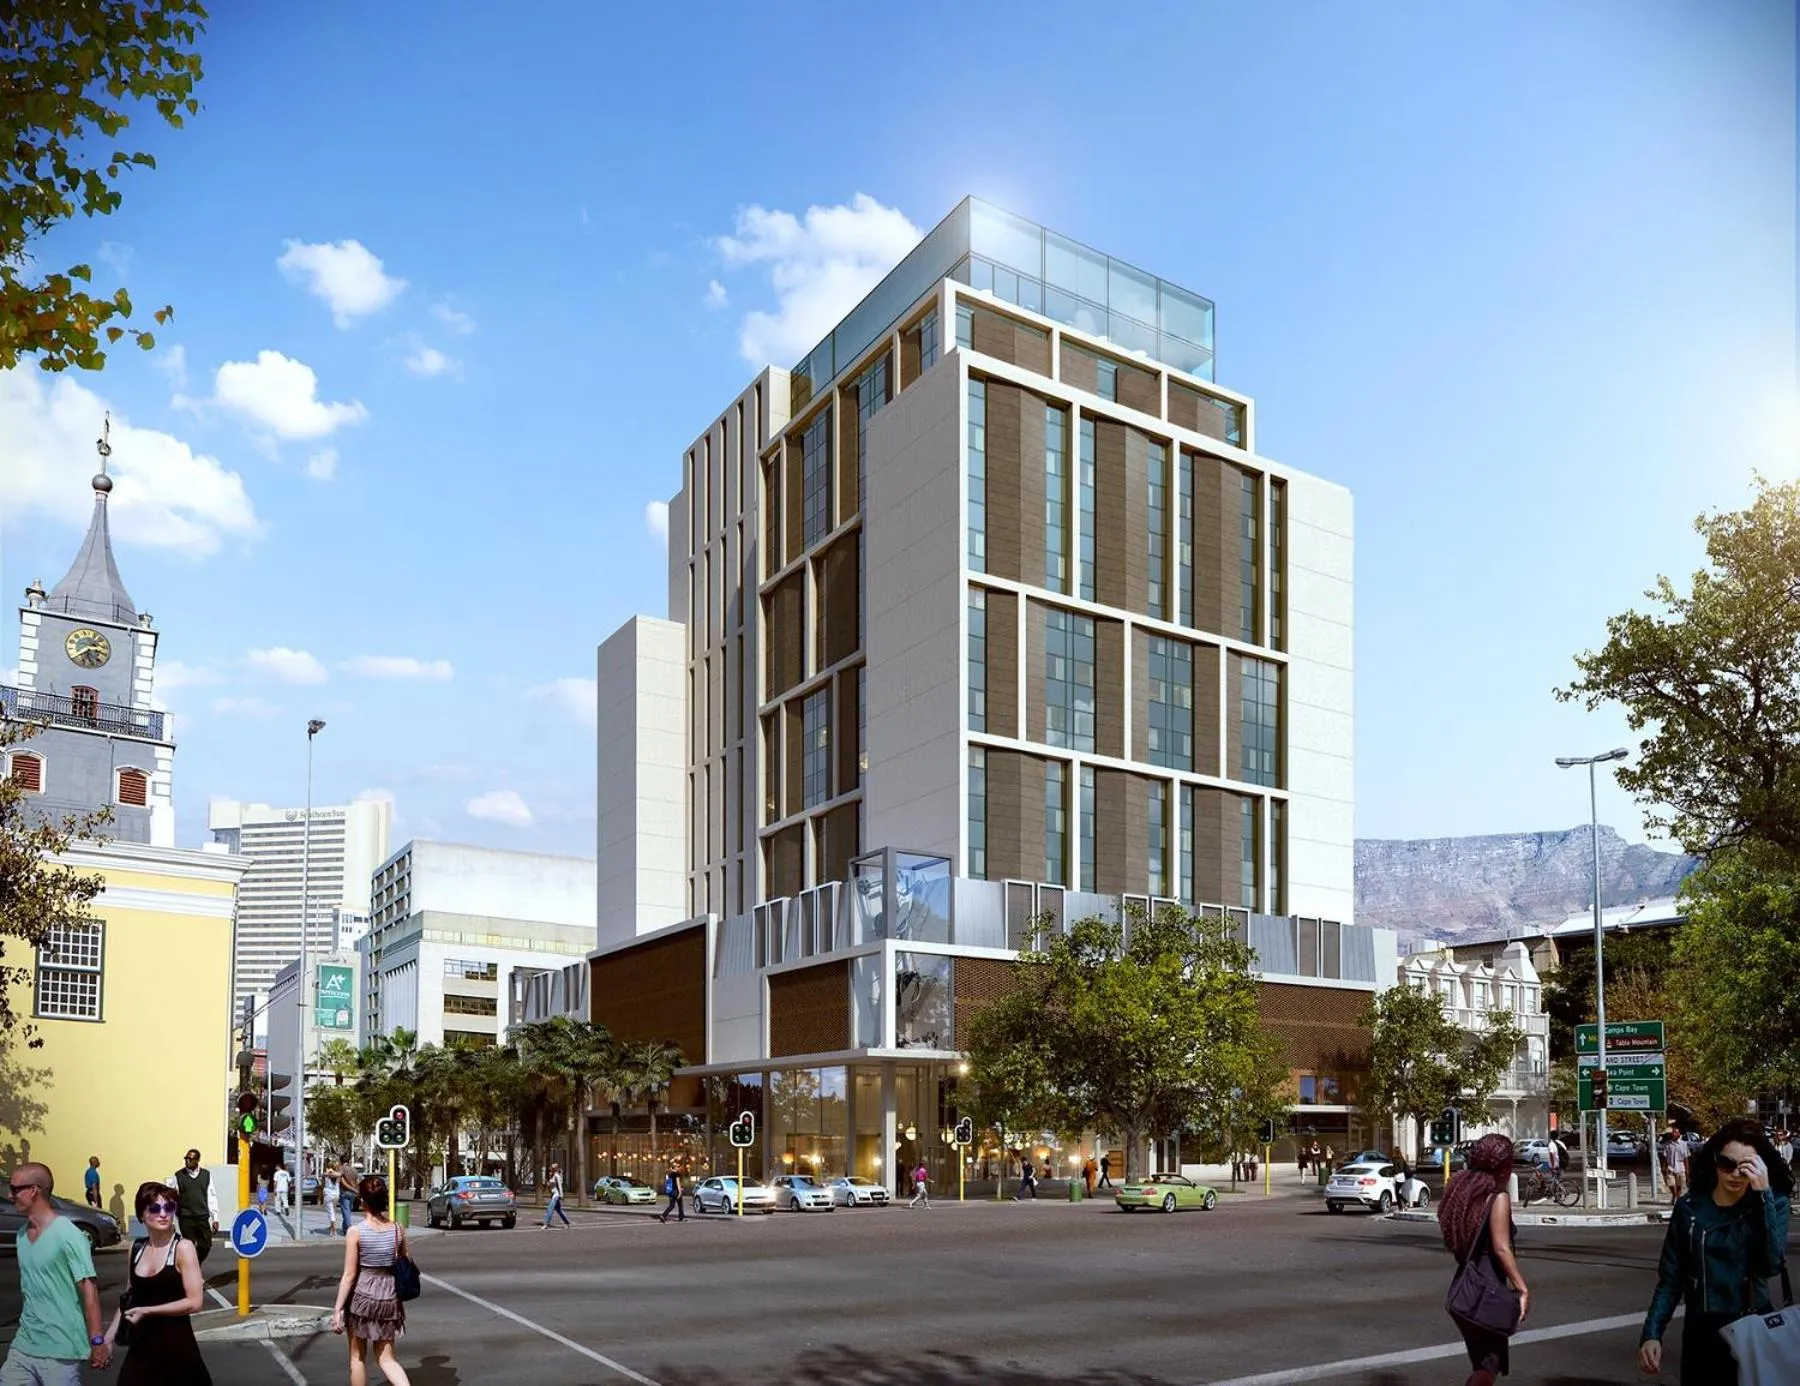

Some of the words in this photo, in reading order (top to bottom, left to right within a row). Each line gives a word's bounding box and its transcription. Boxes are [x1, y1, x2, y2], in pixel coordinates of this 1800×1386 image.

[1625, 1026, 1638, 1034] Bay
[1631, 1038, 1658, 1046] Mountain
[1618, 1068, 1634, 1076] Point
[1614, 1084, 1630, 1093] Cape
[1618, 1097, 1632, 1106] Cape
